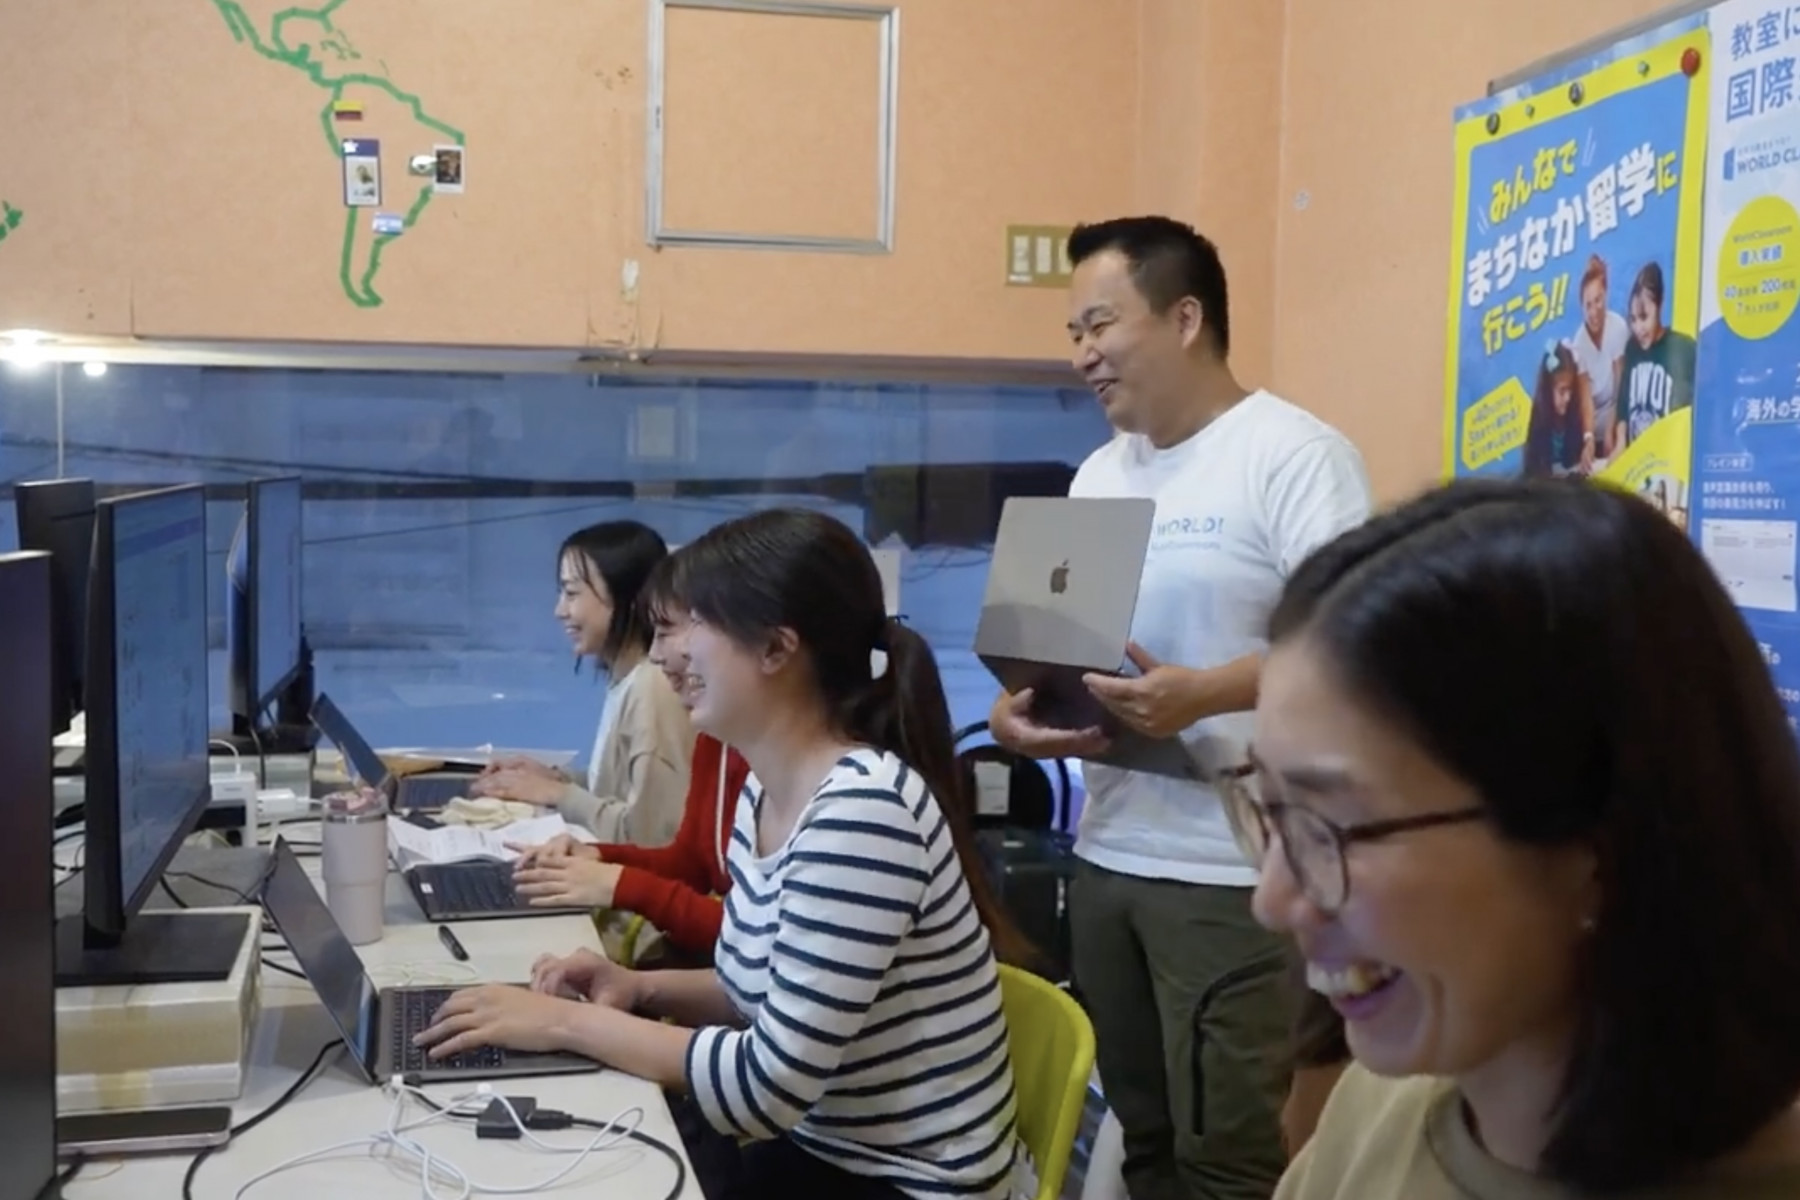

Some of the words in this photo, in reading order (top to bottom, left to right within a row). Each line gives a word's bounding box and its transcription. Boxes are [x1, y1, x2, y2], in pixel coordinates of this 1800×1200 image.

[1730, 7, 1800, 61] 教室に
[1726, 57, 1800, 123] 国際
[1489, 139, 1578, 224] みんなで
[1737, 151, 1781, 174] WORLD
[1467, 142, 1678, 307] まちなか留学に
